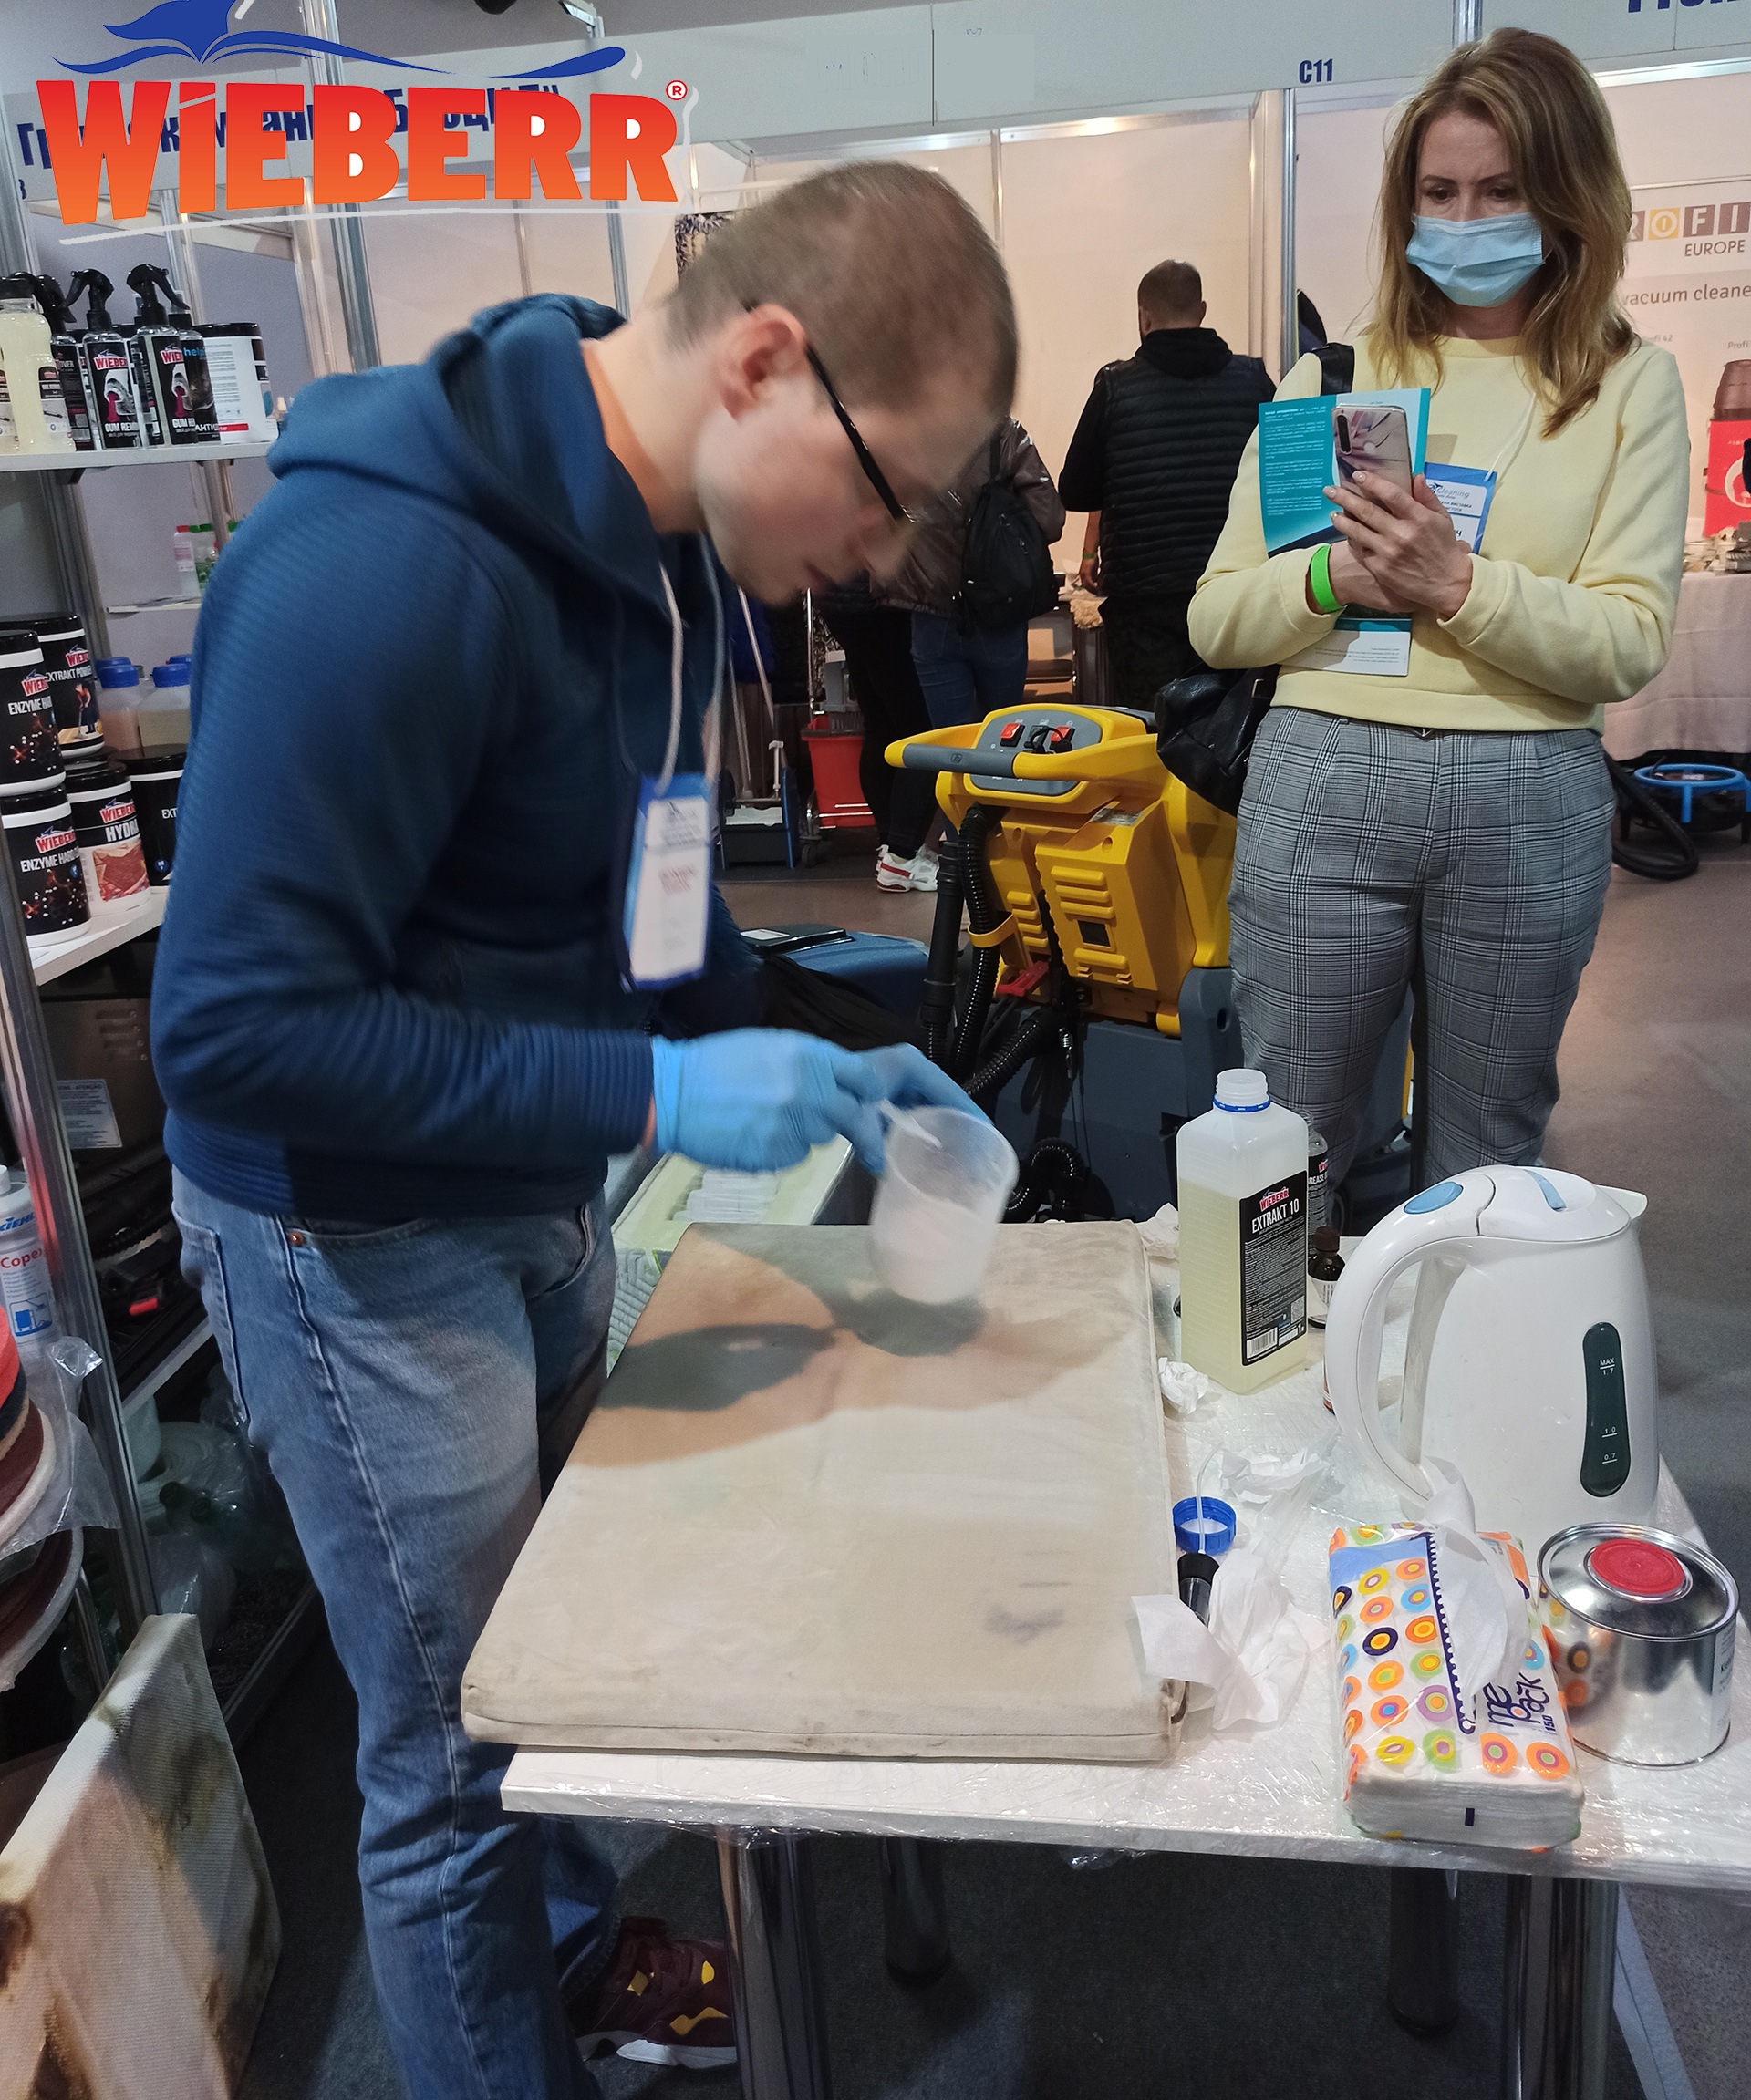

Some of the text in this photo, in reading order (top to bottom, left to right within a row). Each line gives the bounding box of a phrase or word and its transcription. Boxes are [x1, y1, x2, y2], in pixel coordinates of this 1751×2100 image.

[1684, 239, 1746, 257] EUROPE
[8, 698, 42, 716] ENZYME
[21, 853, 59, 873] ENZYME
[1252, 1204, 1287, 1234] EXTRAKT
[1290, 1198, 1300, 1216] 10
[1600, 1358, 1615, 1366] MAX
[1542, 1714, 1557, 1732] 150
